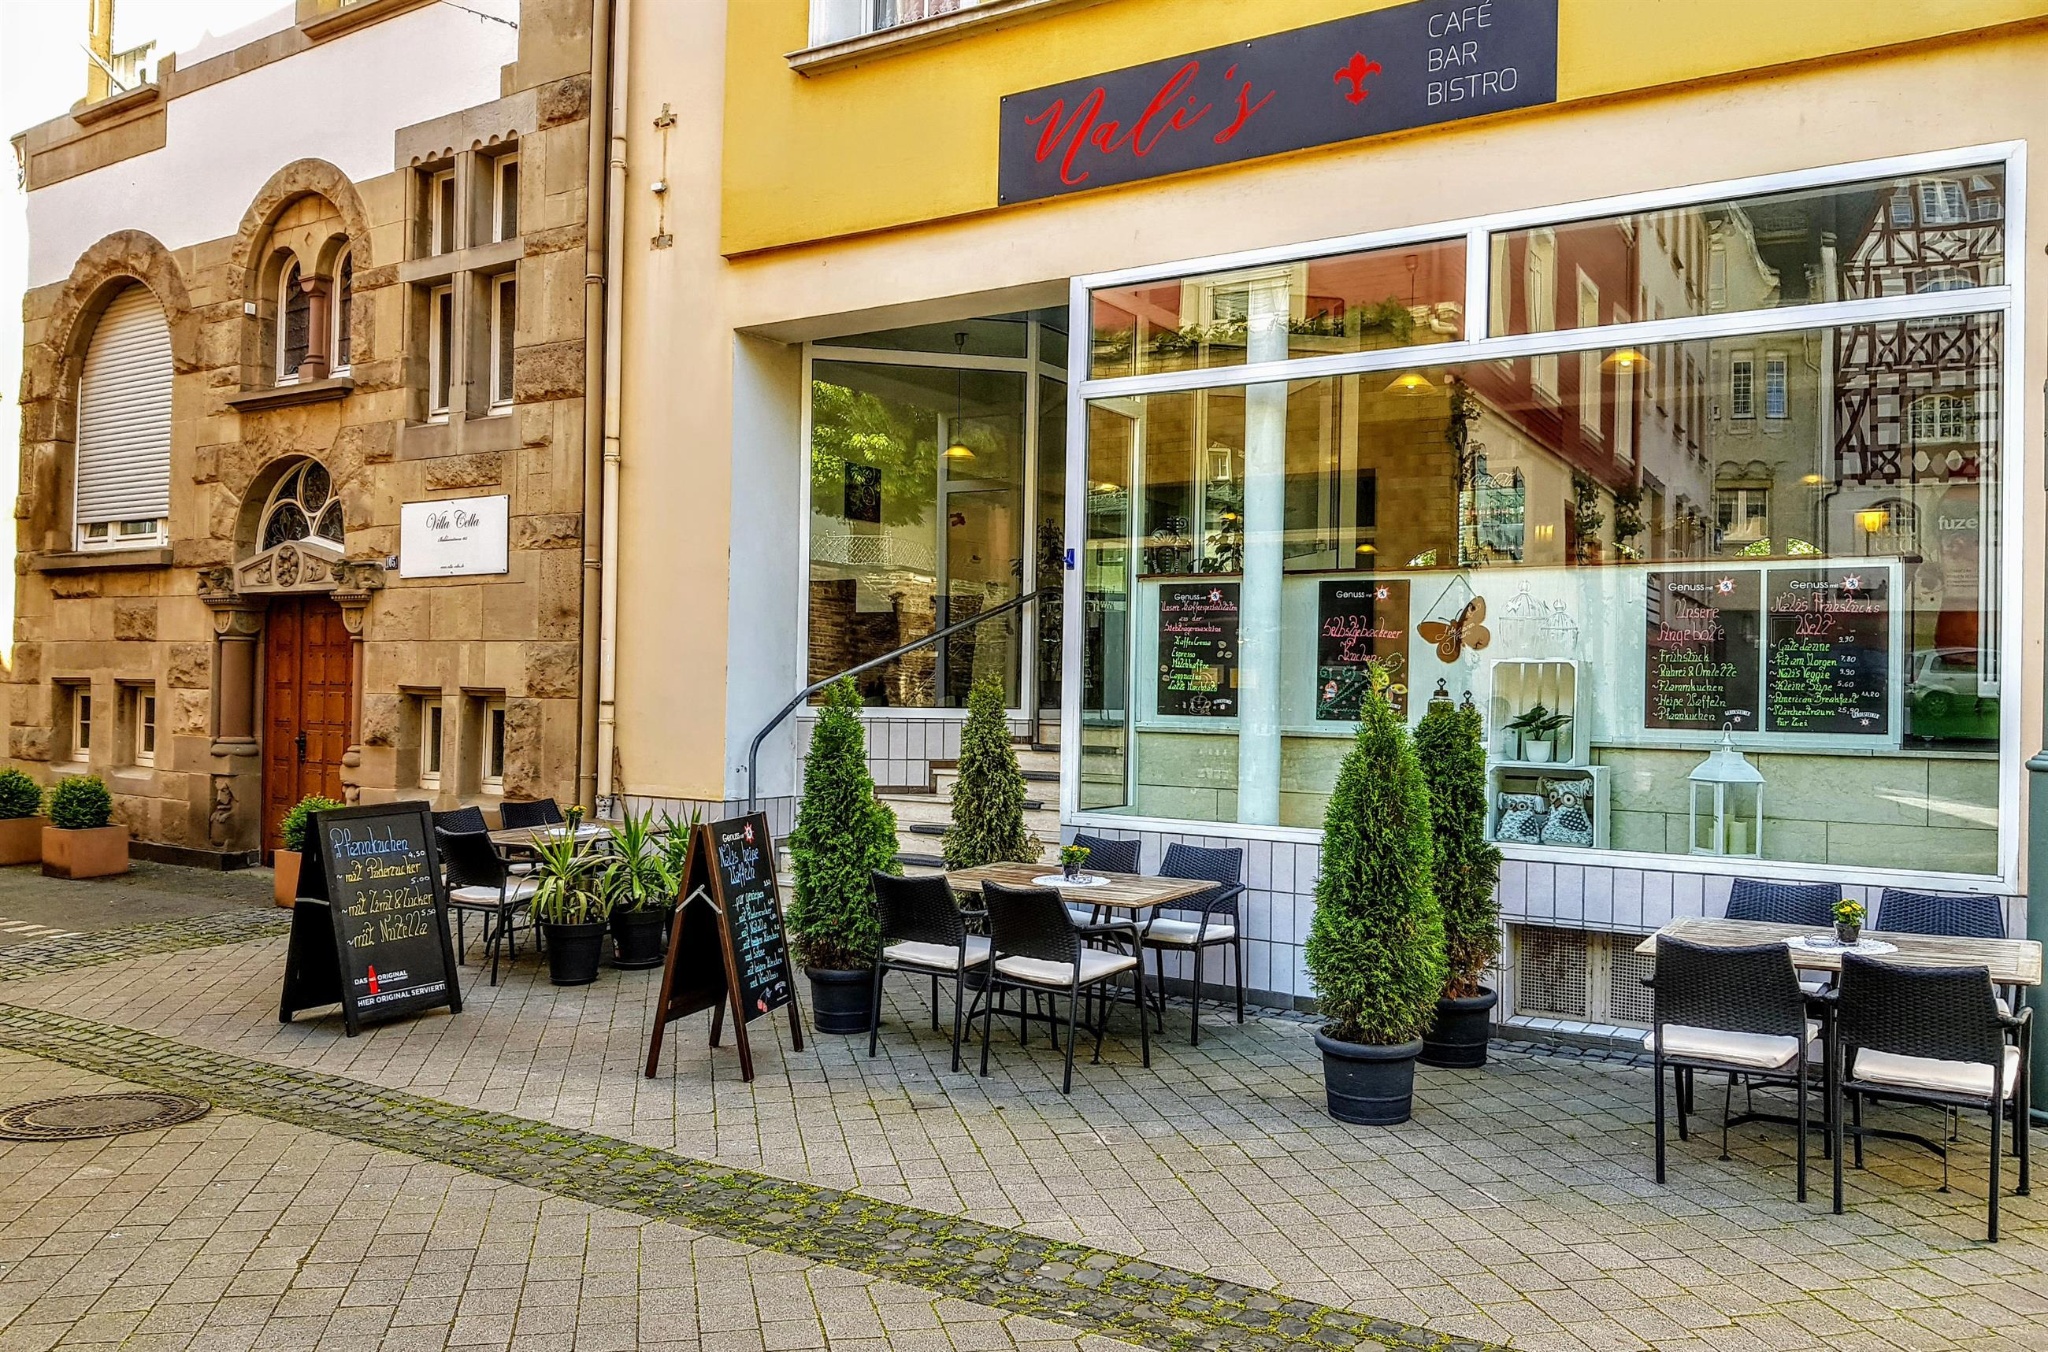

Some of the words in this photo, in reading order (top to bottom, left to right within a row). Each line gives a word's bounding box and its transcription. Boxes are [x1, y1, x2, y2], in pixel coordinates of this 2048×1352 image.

[1428, 0, 1492, 38] CAFÉ
[1428, 41, 1478, 72] BAR
[1427, 67, 1518, 106] BISTRO
[1025, 60, 1277, 186] Nali's
[425, 510, 450, 531] Villa
[453, 509, 480, 529] Cella
[1336, 590, 1365, 599] Genuss
[1668, 583, 1704, 592] Genuss
[1790, 580, 1829, 590] Genuss
[1174, 593, 1200, 601] Genuss
[1675, 598, 1720, 619] Unsere
[1322, 615, 1403, 644] Selbstgebackener
[1657, 620, 1725, 649] Angebote
[1658, 646, 1709, 662] Frühstück
[1657, 678, 1724, 692] Flammkuchen
[1686, 692, 1727, 709] Waffeln
[329, 825, 410, 858] Pfannkuchen
[722, 832, 740, 843] Genuss
[408, 850, 426, 859] 4,50
[345, 860, 363, 882] mit
[365, 855, 422, 879] Puderzucker
[348, 891, 368, 916] mit
[353, 921, 375, 949] mit
[379, 910, 428, 942] Nutella
[354, 977, 368, 986] DAS
[377, 969, 408, 981] ORIGINAL
[357, 997, 376, 1008] HIER
[375, 990, 411, 1004] ORIGINAL
[411, 983, 446, 997] SERVIERT!
